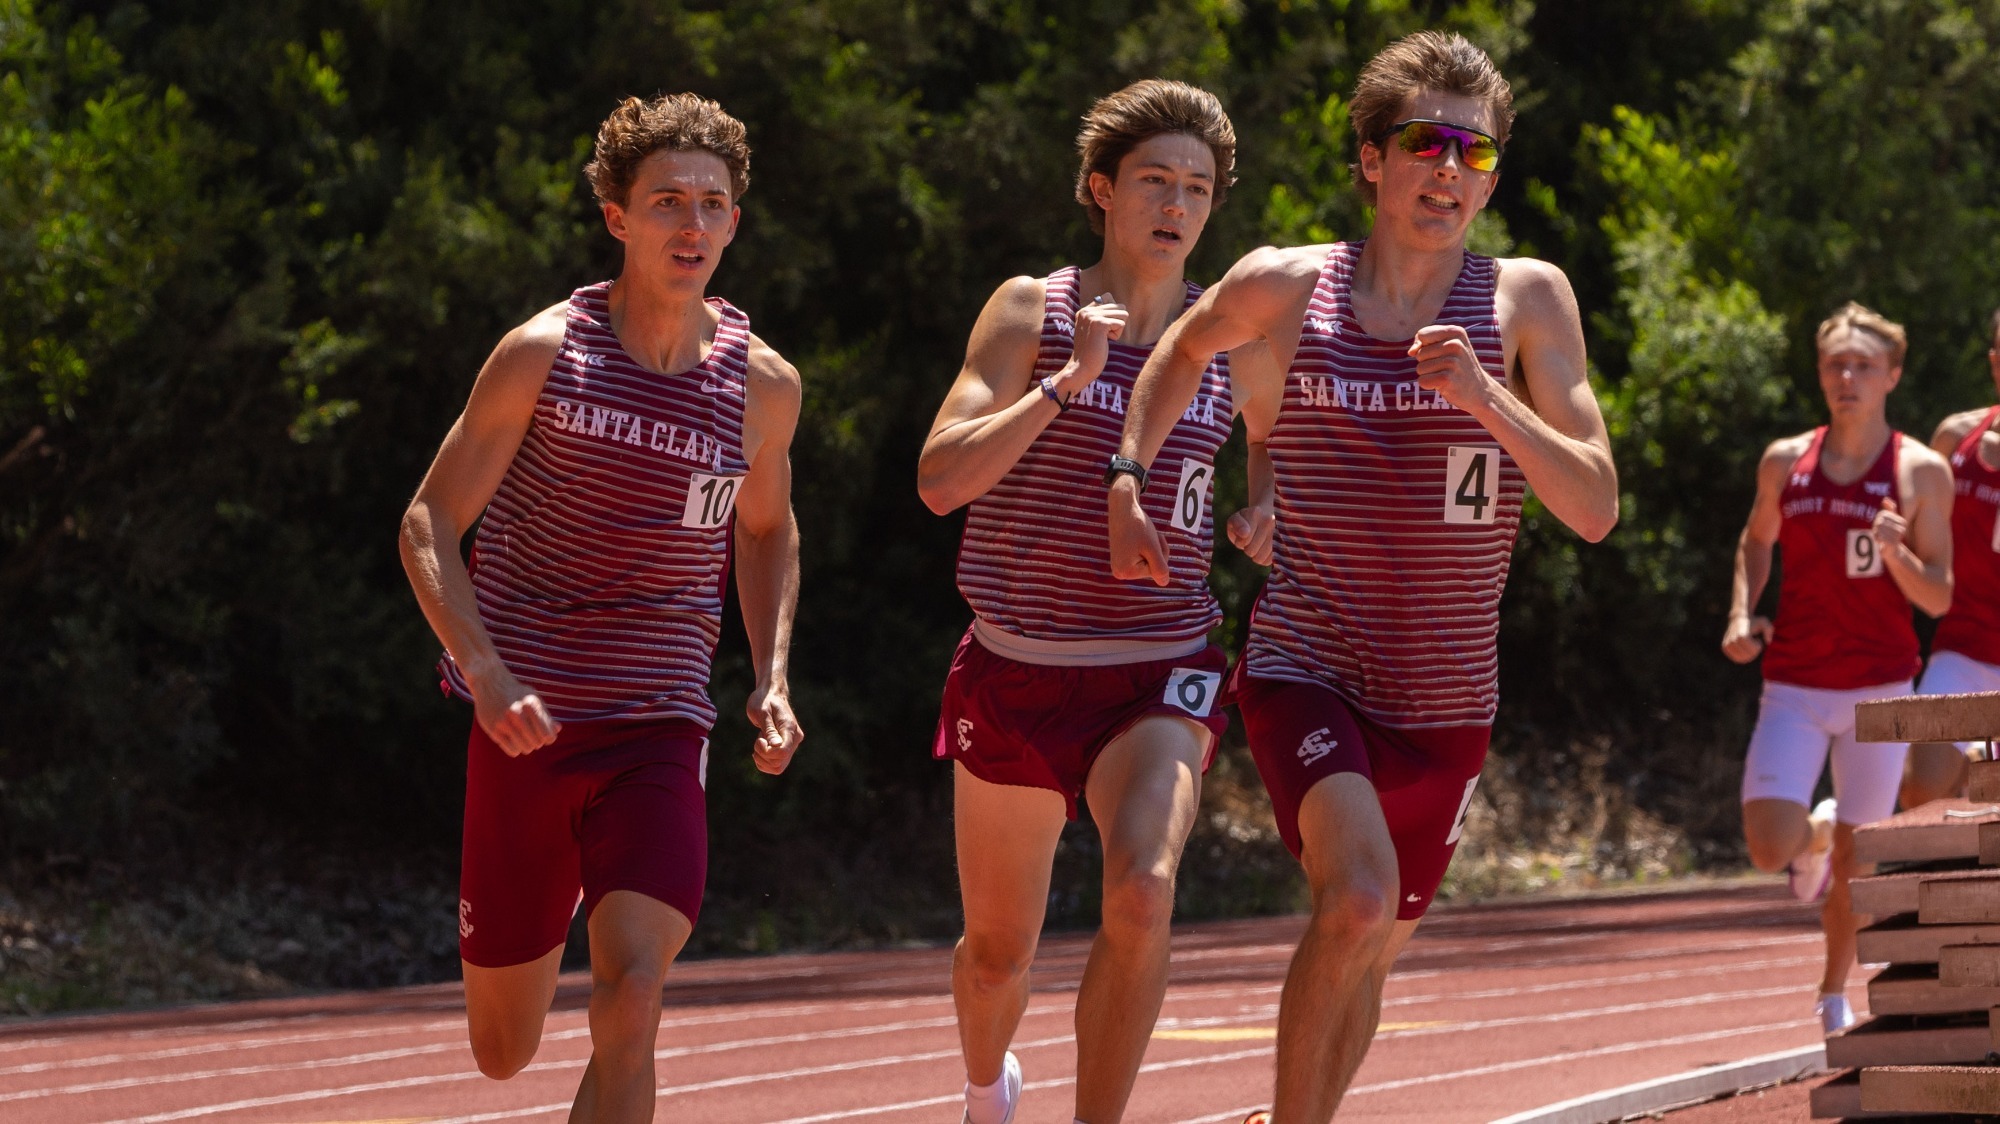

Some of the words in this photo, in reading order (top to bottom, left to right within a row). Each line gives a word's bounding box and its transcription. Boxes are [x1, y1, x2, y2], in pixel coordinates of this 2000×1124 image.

[1068, 380, 1124, 415] NTA
[1300, 376, 1387, 412] SANTA
[1396, 381, 1461, 411] CLA
[554, 400, 642, 446] SANTA
[650, 421, 723, 474] CLARA
[699, 478, 735, 525] 10
[1182, 467, 1207, 529] 6
[1454, 453, 1491, 521] 4
[1828, 498, 1877, 522] MARY
[1855, 534, 1874, 572] 9
[1177, 673, 1207, 711] 6
